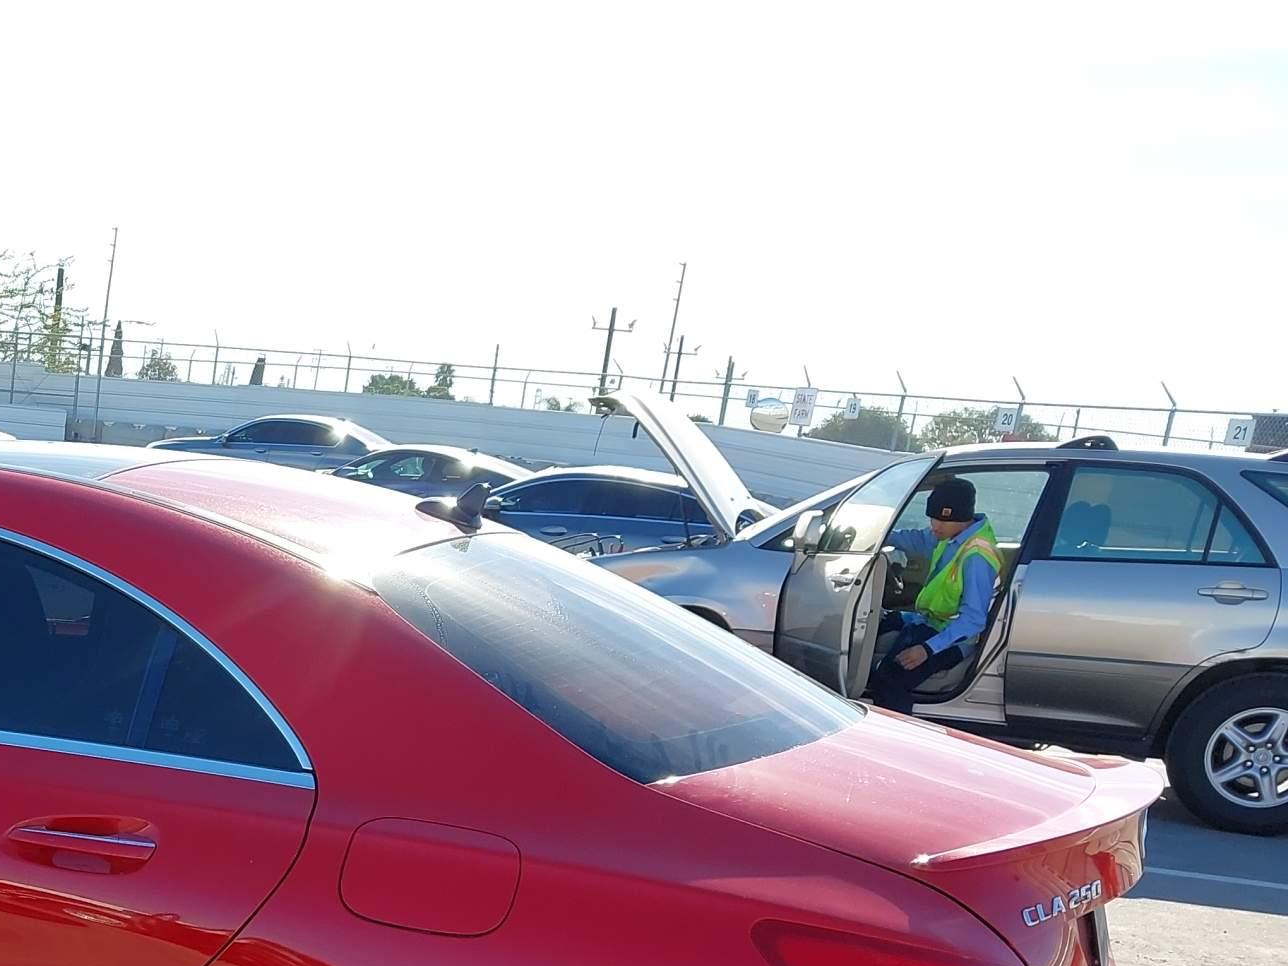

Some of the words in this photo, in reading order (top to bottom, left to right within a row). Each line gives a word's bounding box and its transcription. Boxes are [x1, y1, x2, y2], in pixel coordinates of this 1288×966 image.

[797, 393, 815, 405] STATE
[793, 408, 809, 418] FARM
[848, 403, 857, 413] 19
[1001, 413, 1014, 426] 20
[1232, 426, 1248, 441] 21
[1021, 896, 1067, 926] CLA
[1069, 880, 1101, 909] 250
